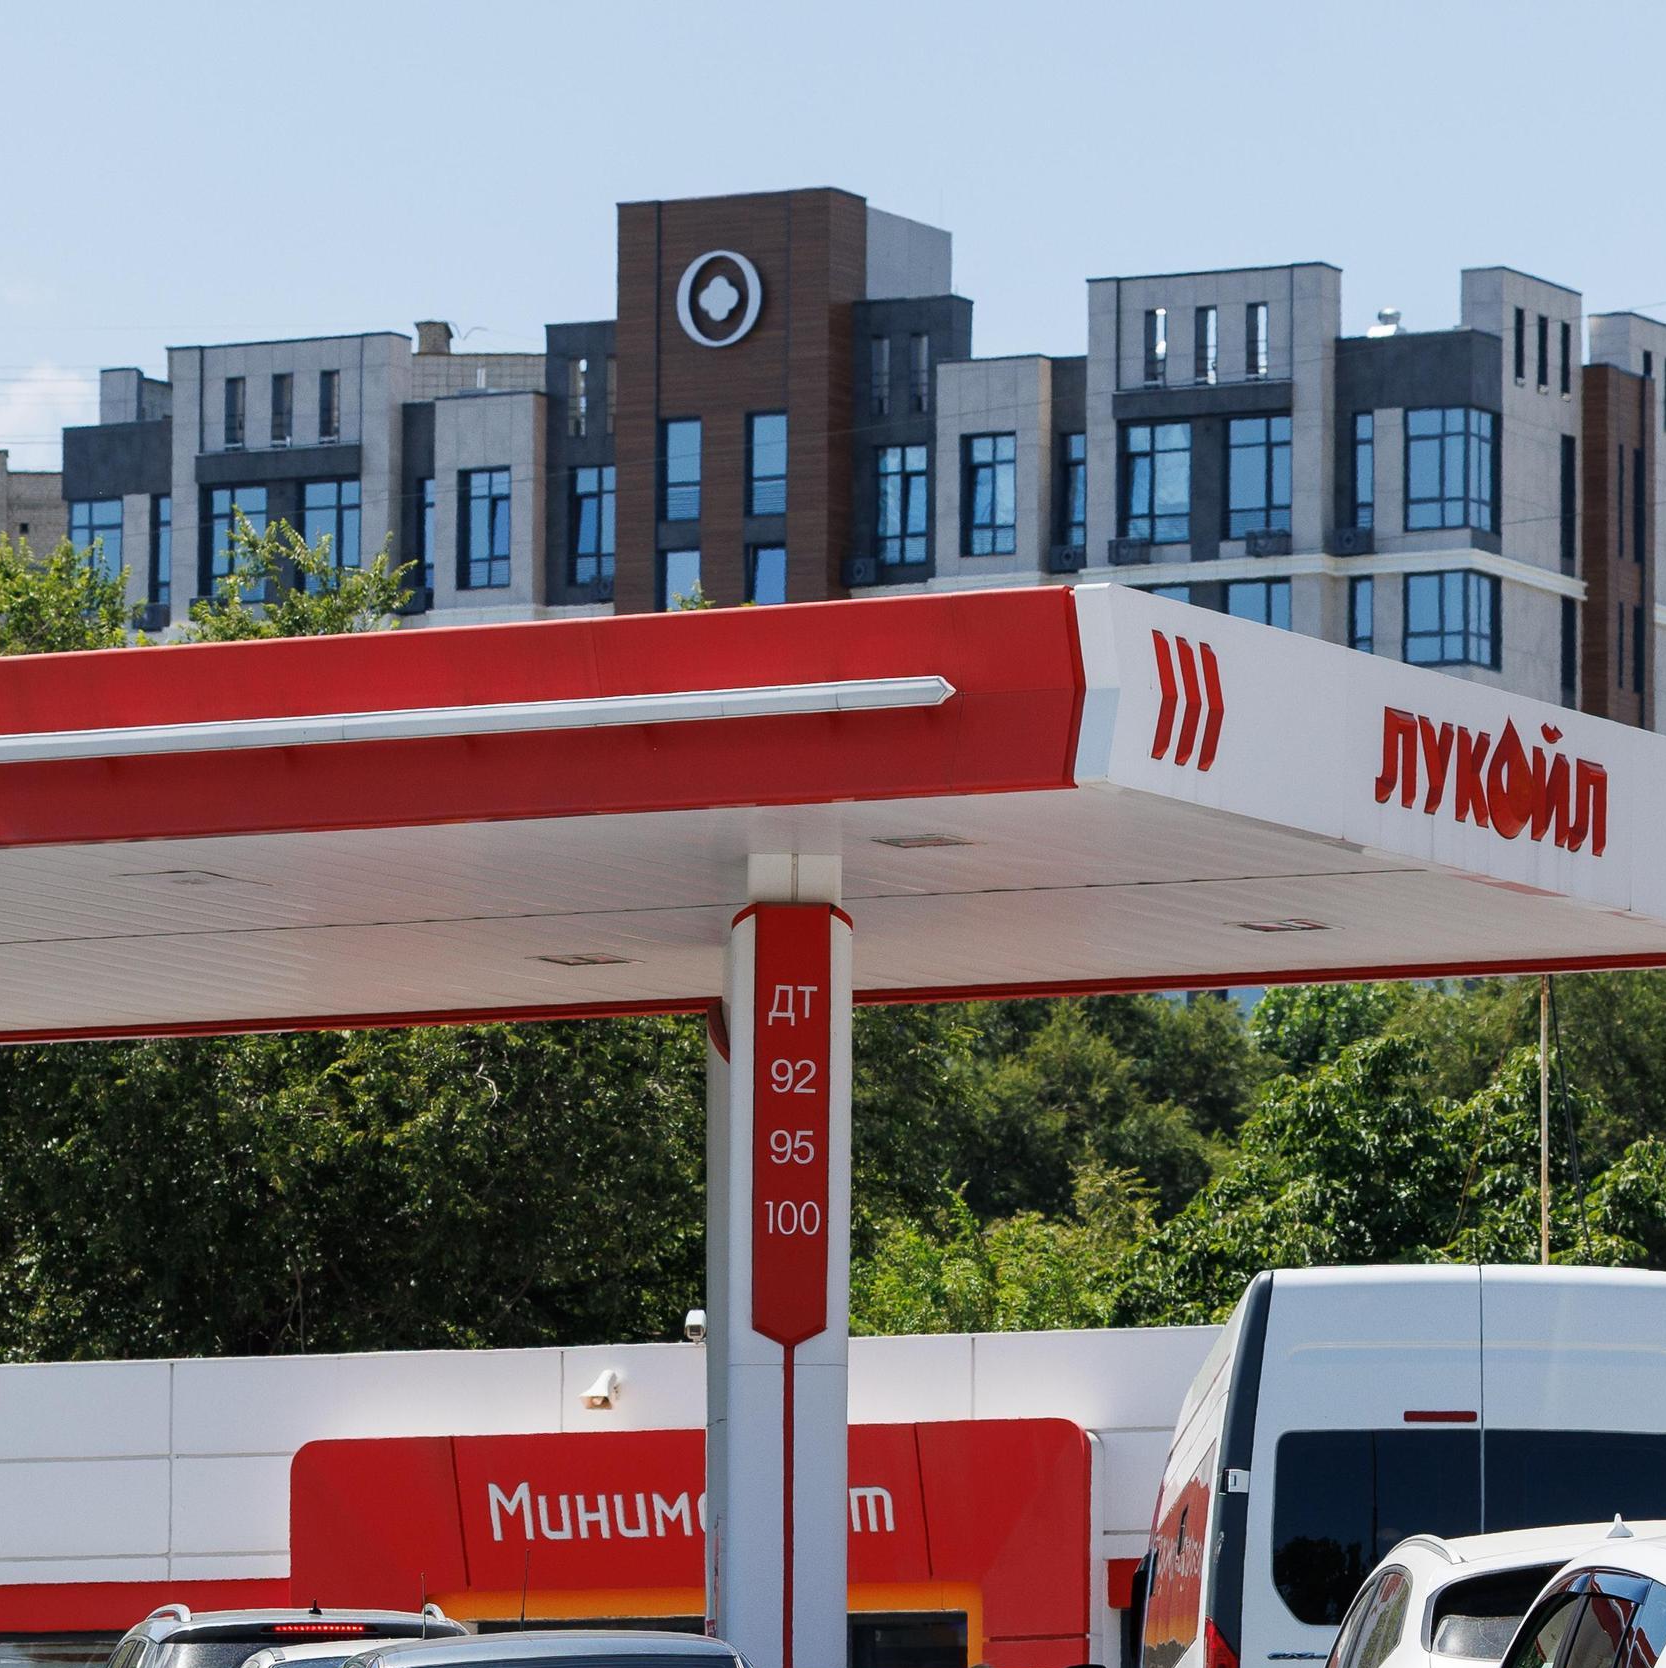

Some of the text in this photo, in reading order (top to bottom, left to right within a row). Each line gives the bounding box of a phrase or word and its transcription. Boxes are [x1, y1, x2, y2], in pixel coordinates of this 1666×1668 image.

[1374, 706, 1608, 857] ЛУКОЙЛ
[767, 984, 818, 1027] ДТ
[770, 1058, 817, 1094] 92
[769, 1129, 815, 1165] 95
[764, 1200, 821, 1236] 100
[488, 1482, 895, 1541] Минимт
